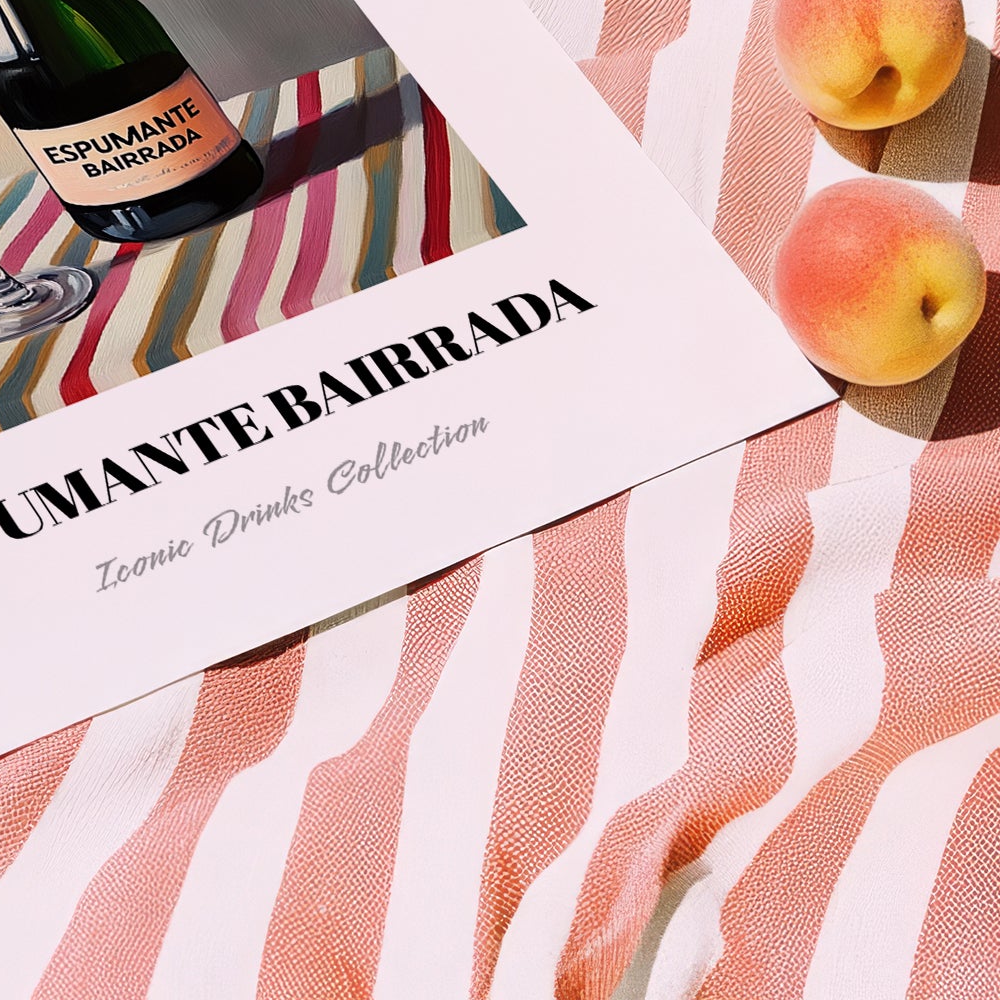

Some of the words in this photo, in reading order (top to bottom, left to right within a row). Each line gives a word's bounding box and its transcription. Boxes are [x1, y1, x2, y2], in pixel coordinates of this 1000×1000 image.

[42, 97, 201, 164] ESPUMANTE
[82, 128, 203, 178] BAIRRADA
[262, 278, 599, 433] BAIRRADA
[95, 537, 194, 593] Iconic
[202, 484, 315, 549] Drinks
[326, 416, 491, 496] Collection
